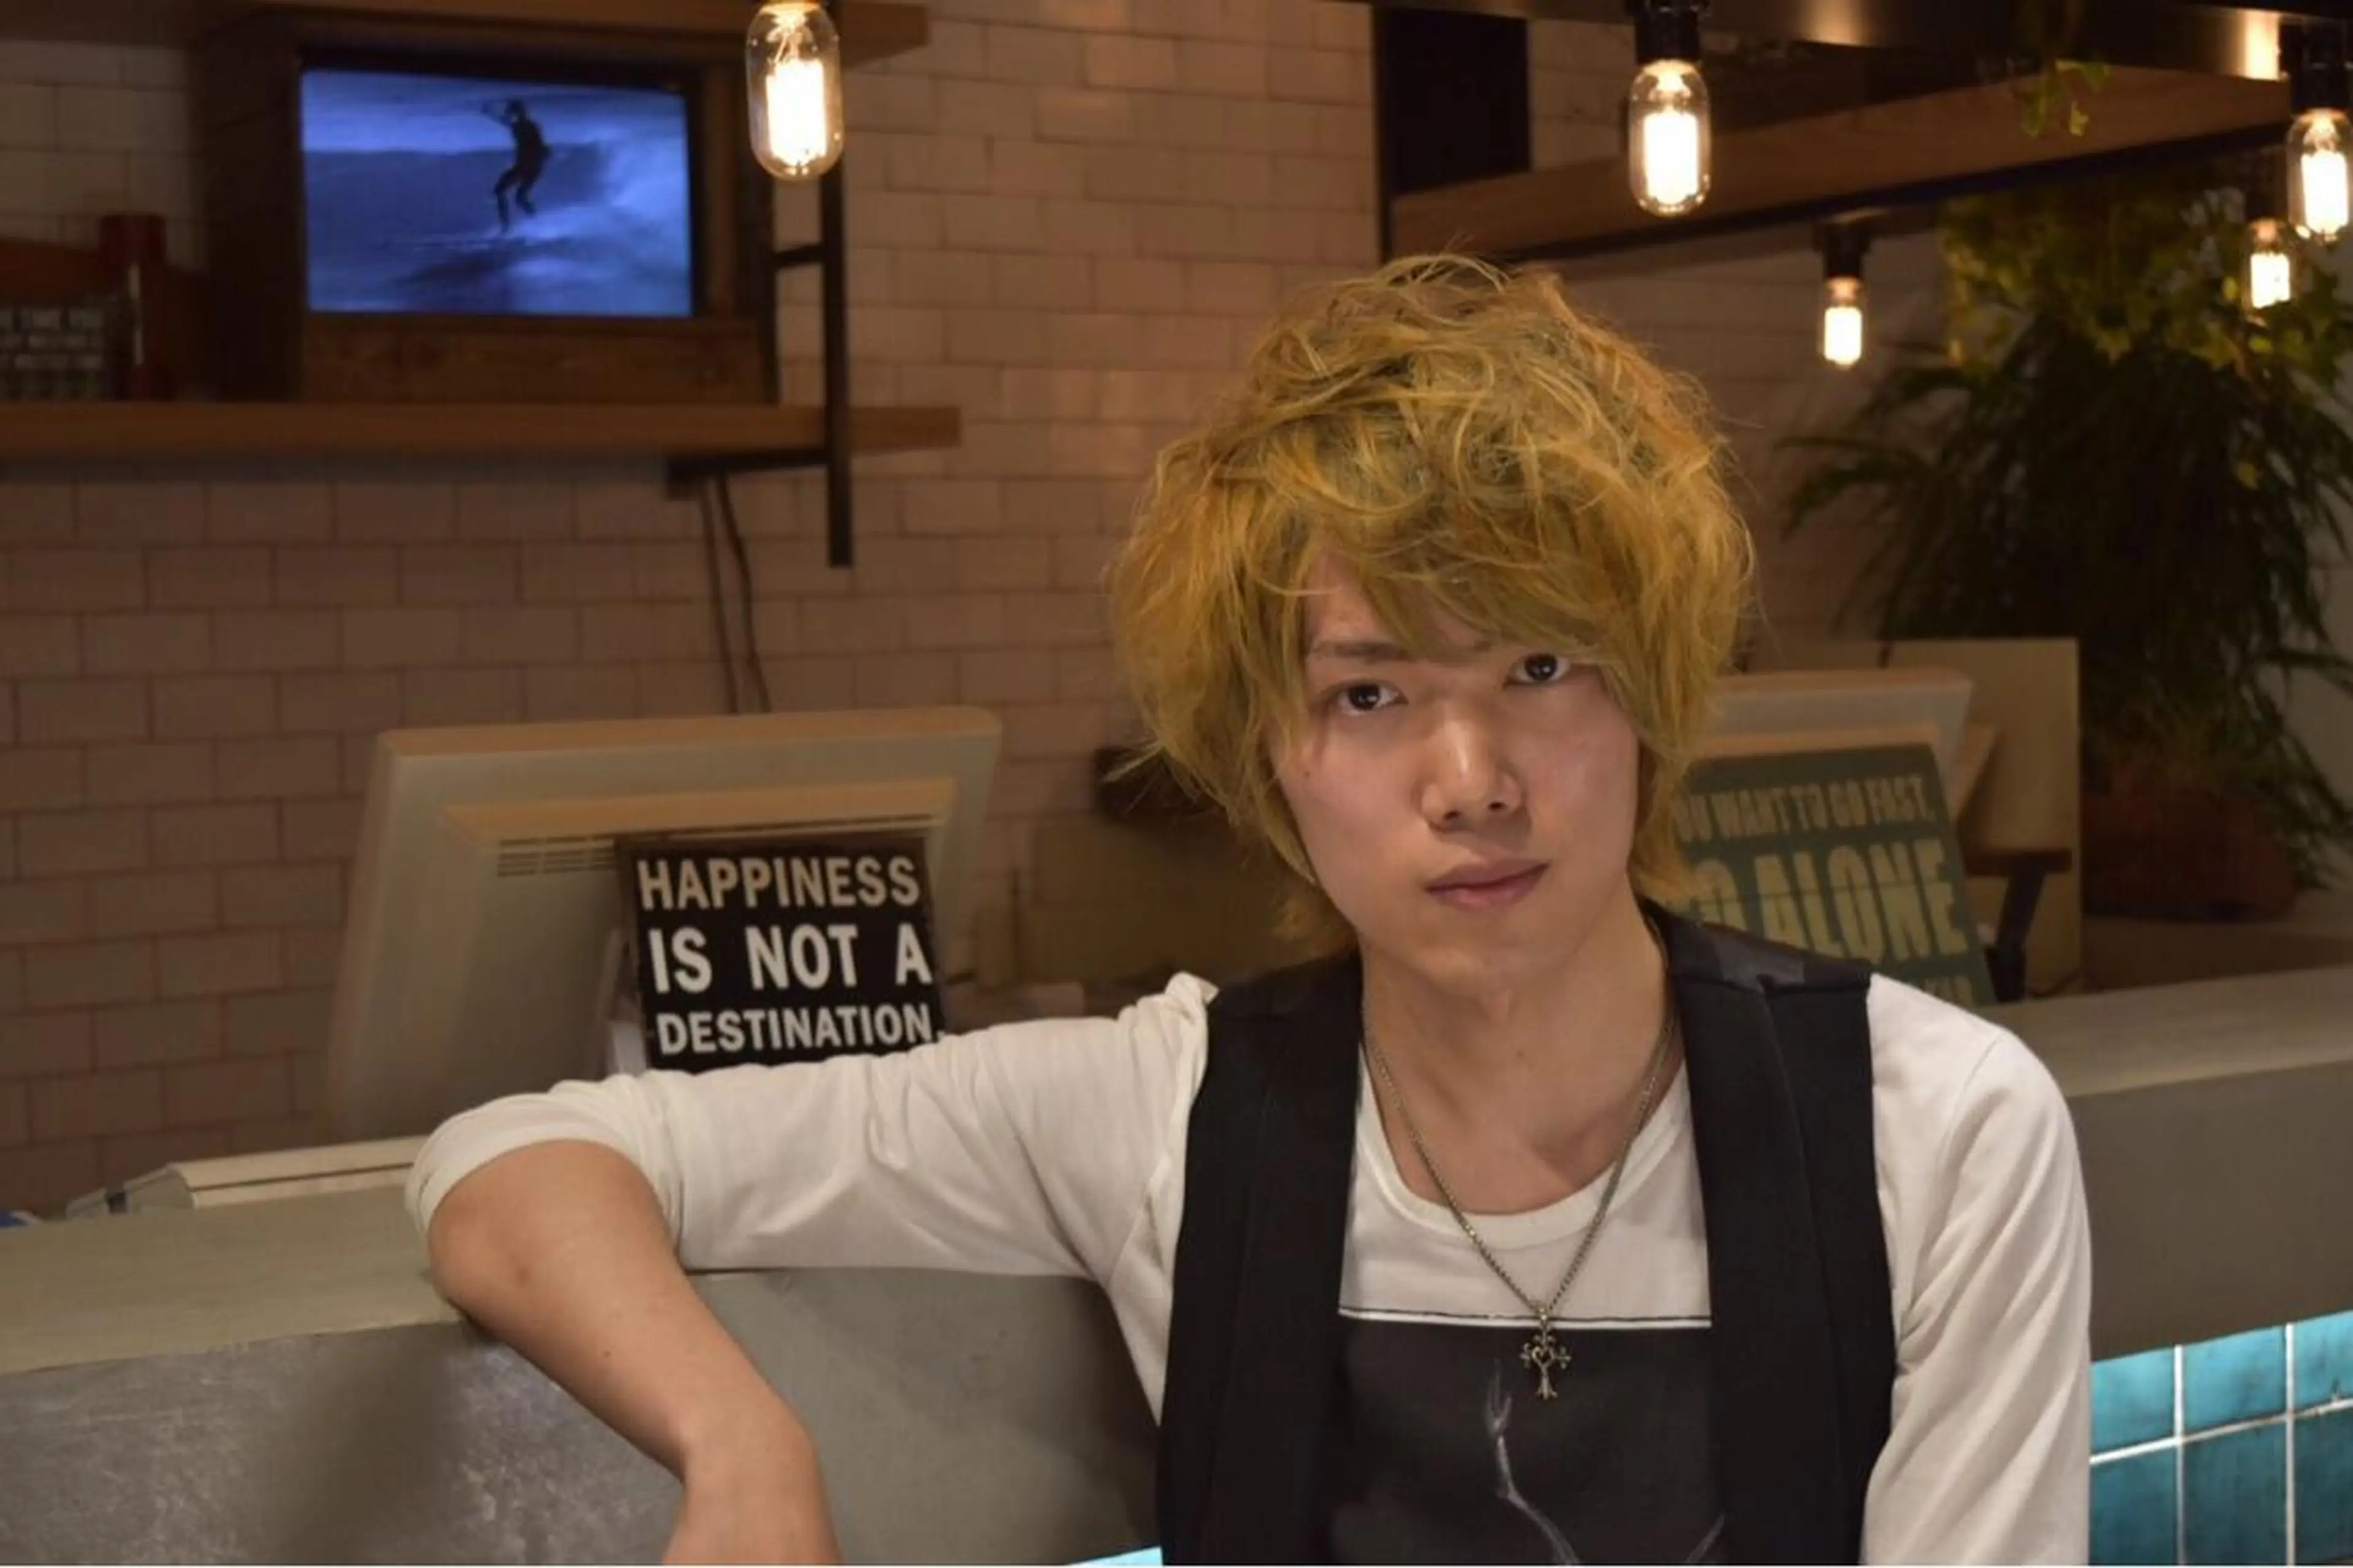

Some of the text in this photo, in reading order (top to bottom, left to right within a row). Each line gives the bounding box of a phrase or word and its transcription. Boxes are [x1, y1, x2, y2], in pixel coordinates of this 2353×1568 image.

[1673, 792, 1714, 842] OU
[1711, 787, 1791, 840] WANT
[1789, 782, 1828, 830] TO
[1828, 778, 1867, 827] GO
[637, 855, 919, 910] HAPPINESS
[1754, 838, 1969, 966] ALONE
[647, 922, 933, 994] IS NOT A
